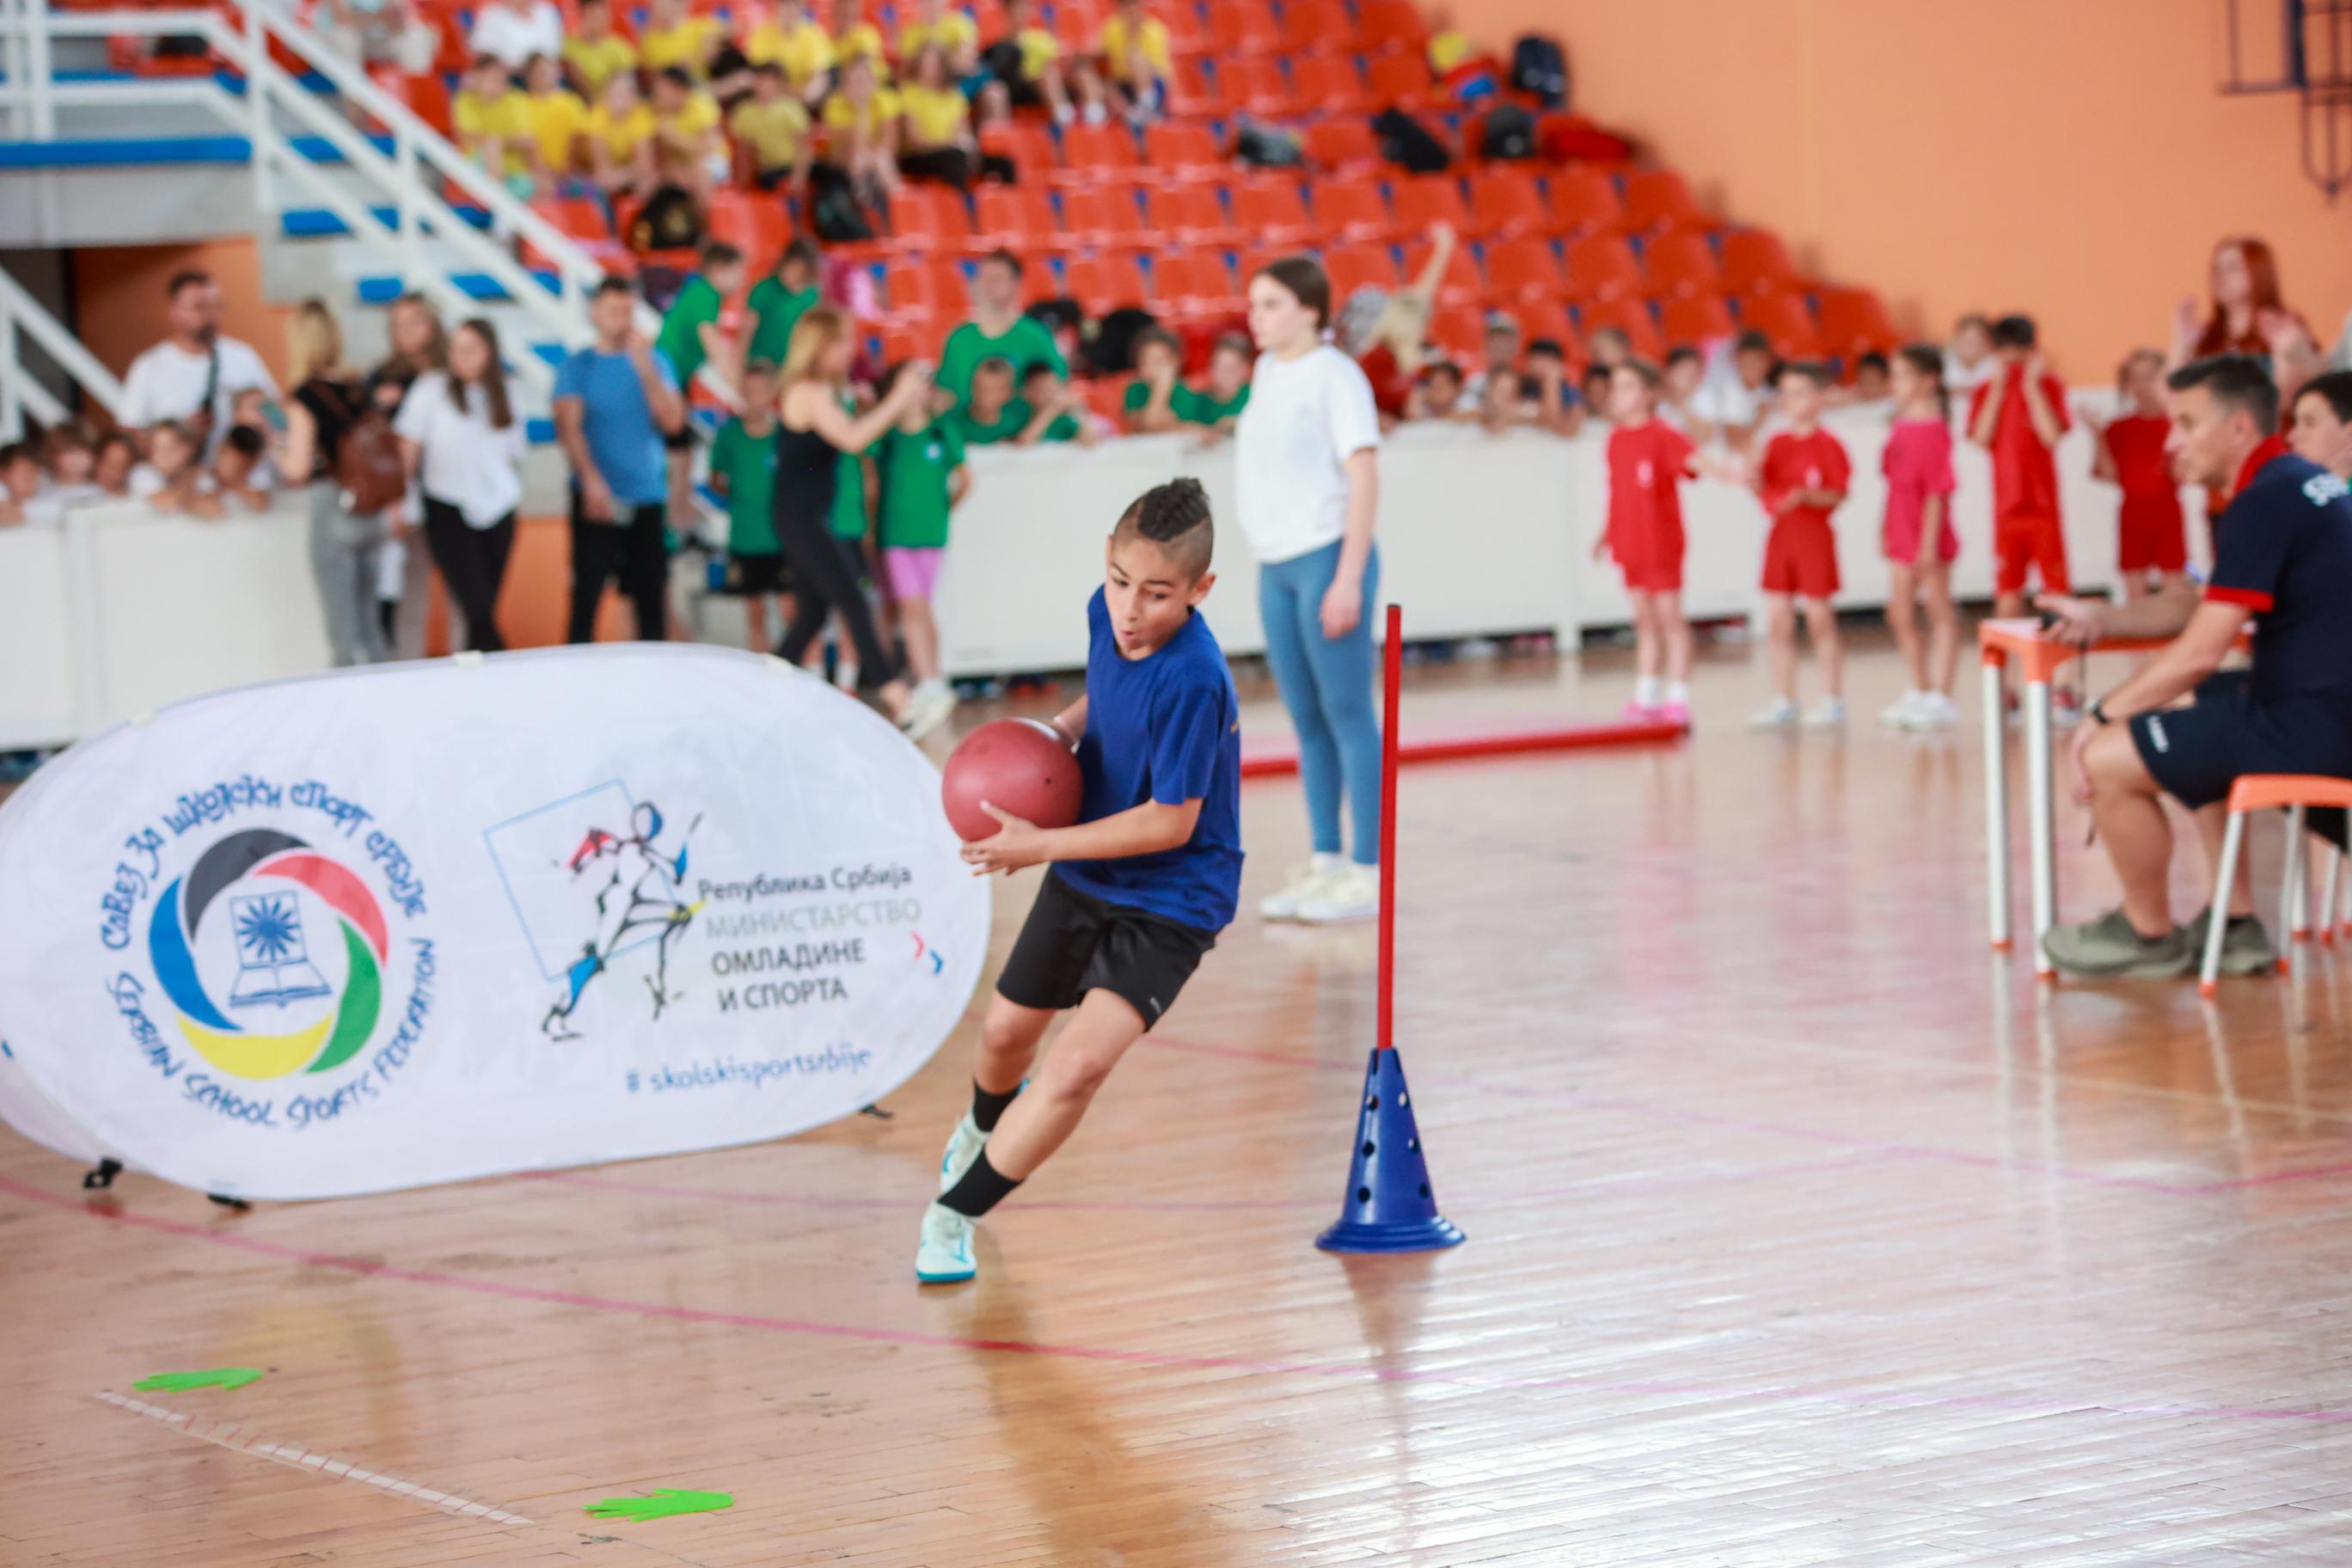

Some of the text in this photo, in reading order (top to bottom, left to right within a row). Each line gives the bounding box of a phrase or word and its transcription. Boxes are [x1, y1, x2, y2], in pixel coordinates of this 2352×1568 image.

[697, 861, 912, 903] Република Србија
[706, 897, 922, 939] МИНИСТАРСТВО
[712, 938, 866, 976] ОМЛАДИНЕ
[718, 977, 848, 1012] И СПОРТА
[181, 1073, 278, 1126] SCHOOL
